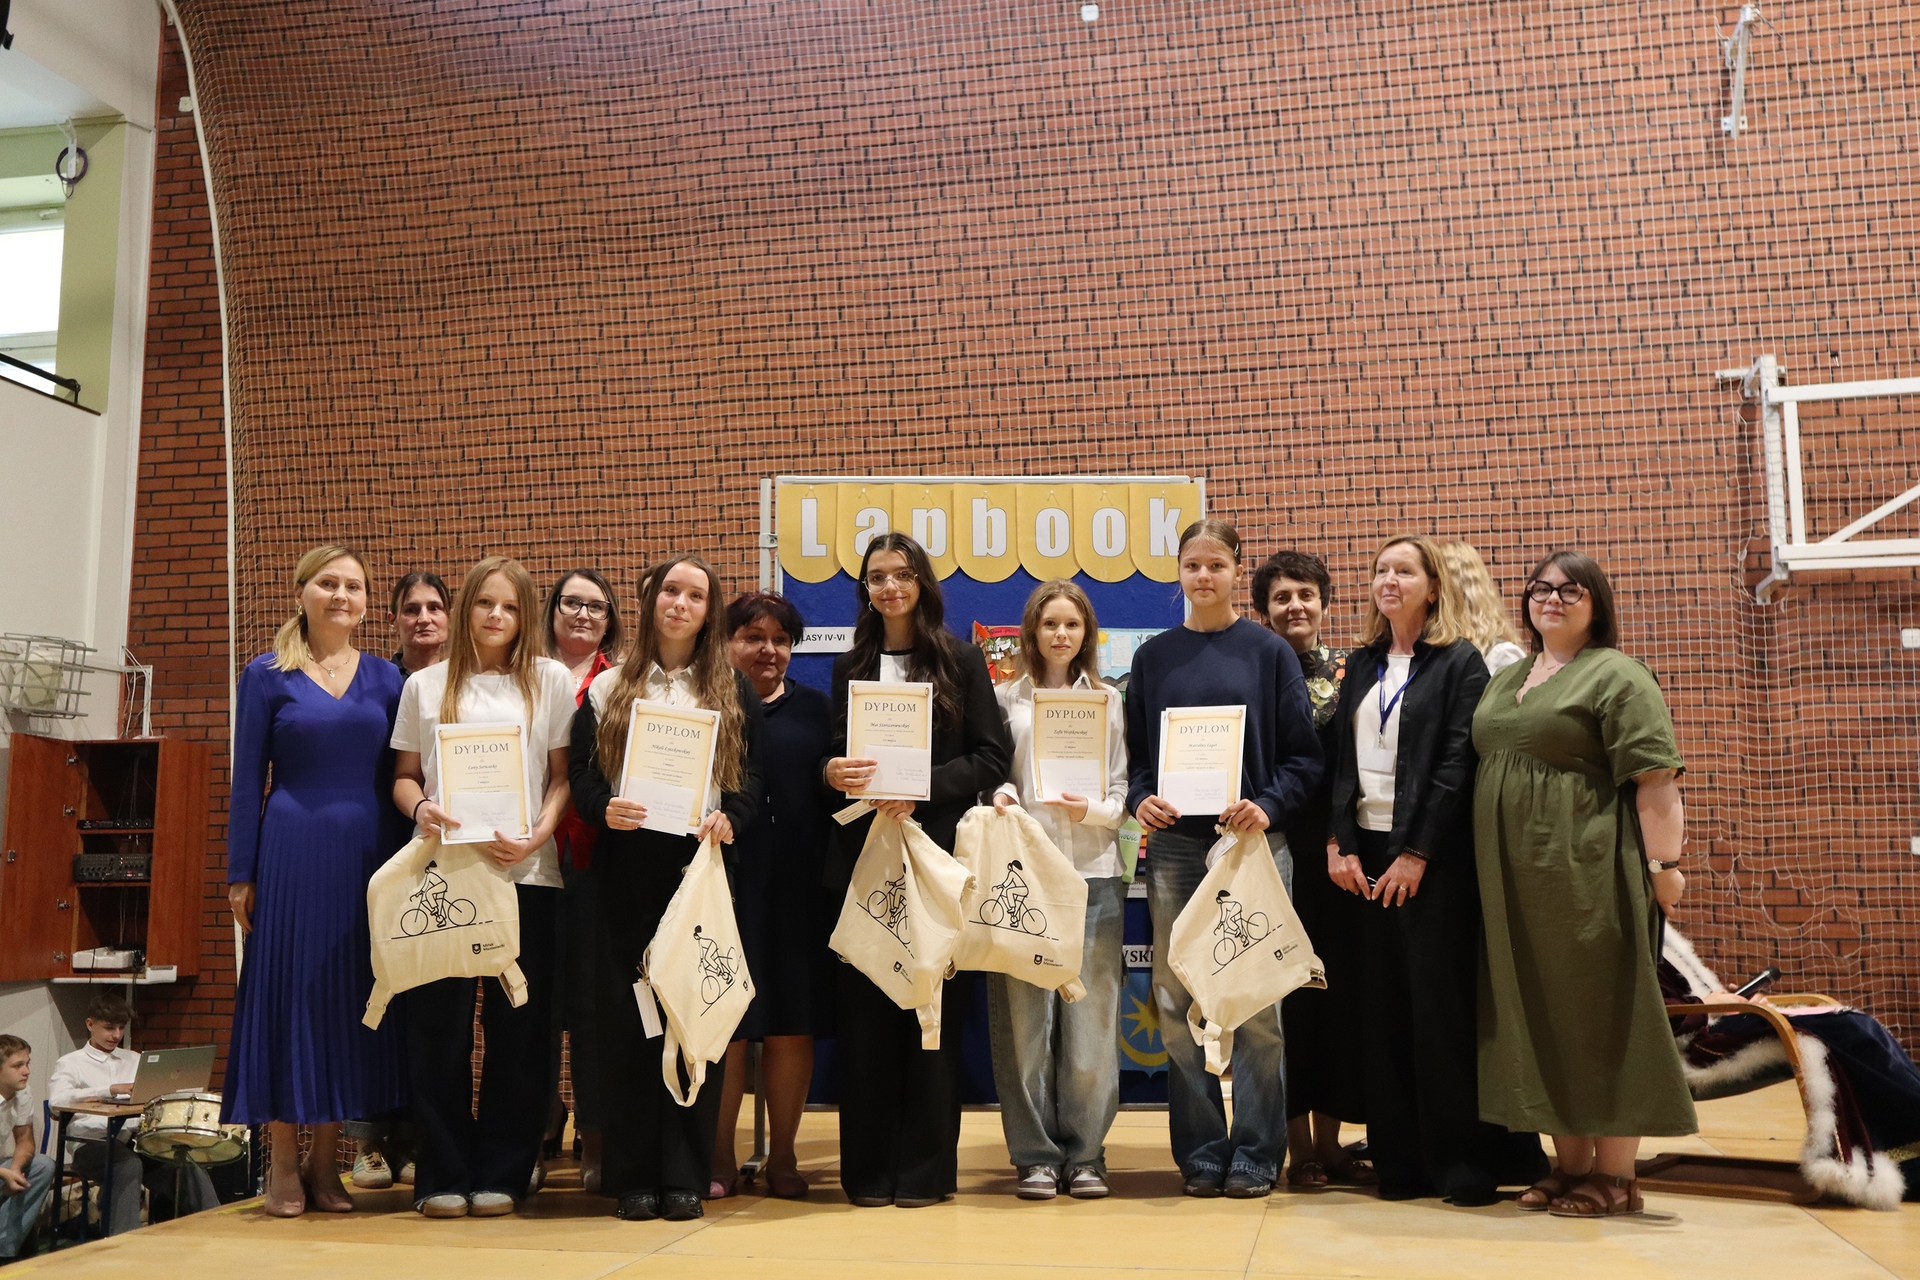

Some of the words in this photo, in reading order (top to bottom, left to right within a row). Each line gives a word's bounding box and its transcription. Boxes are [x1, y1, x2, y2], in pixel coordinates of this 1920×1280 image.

[801, 497, 1182, 558] Lapbook
[801, 633, 823, 642] LASY
[824, 633, 846, 641] IV-VI
[864, 702, 917, 713] DYPLOM
[1046, 709, 1096, 720] DYPLOM
[647, 722, 702, 740] DYPLOM
[1179, 724, 1230, 735] DYPLOM
[454, 742, 510, 755] DYPLOM
